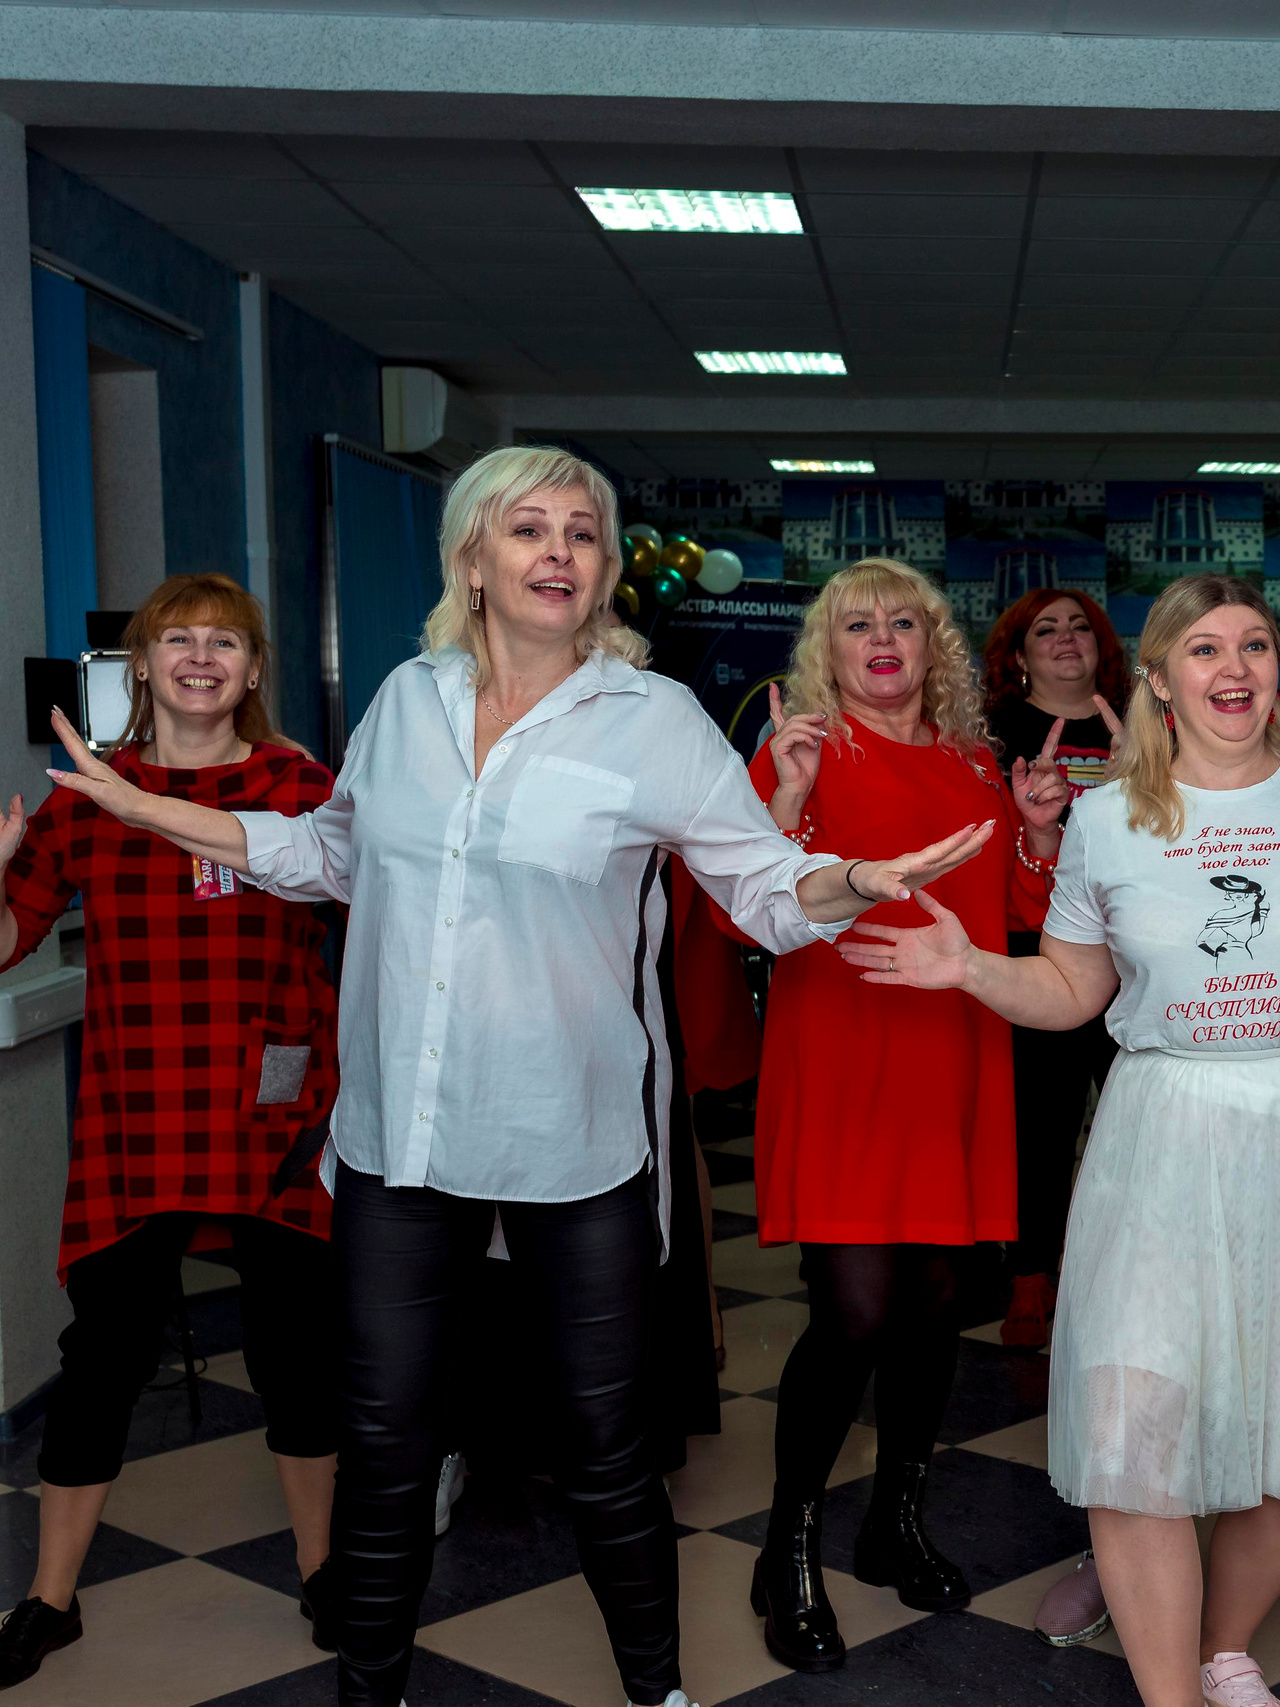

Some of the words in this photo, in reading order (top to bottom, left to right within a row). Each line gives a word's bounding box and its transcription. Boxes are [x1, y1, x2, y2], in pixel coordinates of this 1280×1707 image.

[674, 598, 768, 617] АСТЕР-КЛАССЫ
[1192, 826, 1214, 841] Я
[1214, 827, 1231, 837] не
[1234, 825, 1276, 837] знаю,
[1163, 847, 1193, 858] что
[1197, 841, 1243, 858] будет
[1197, 857, 1228, 870] мое
[1232, 855, 1271, 868] дело:
[1204, 971, 1278, 994] БЫТЬ
